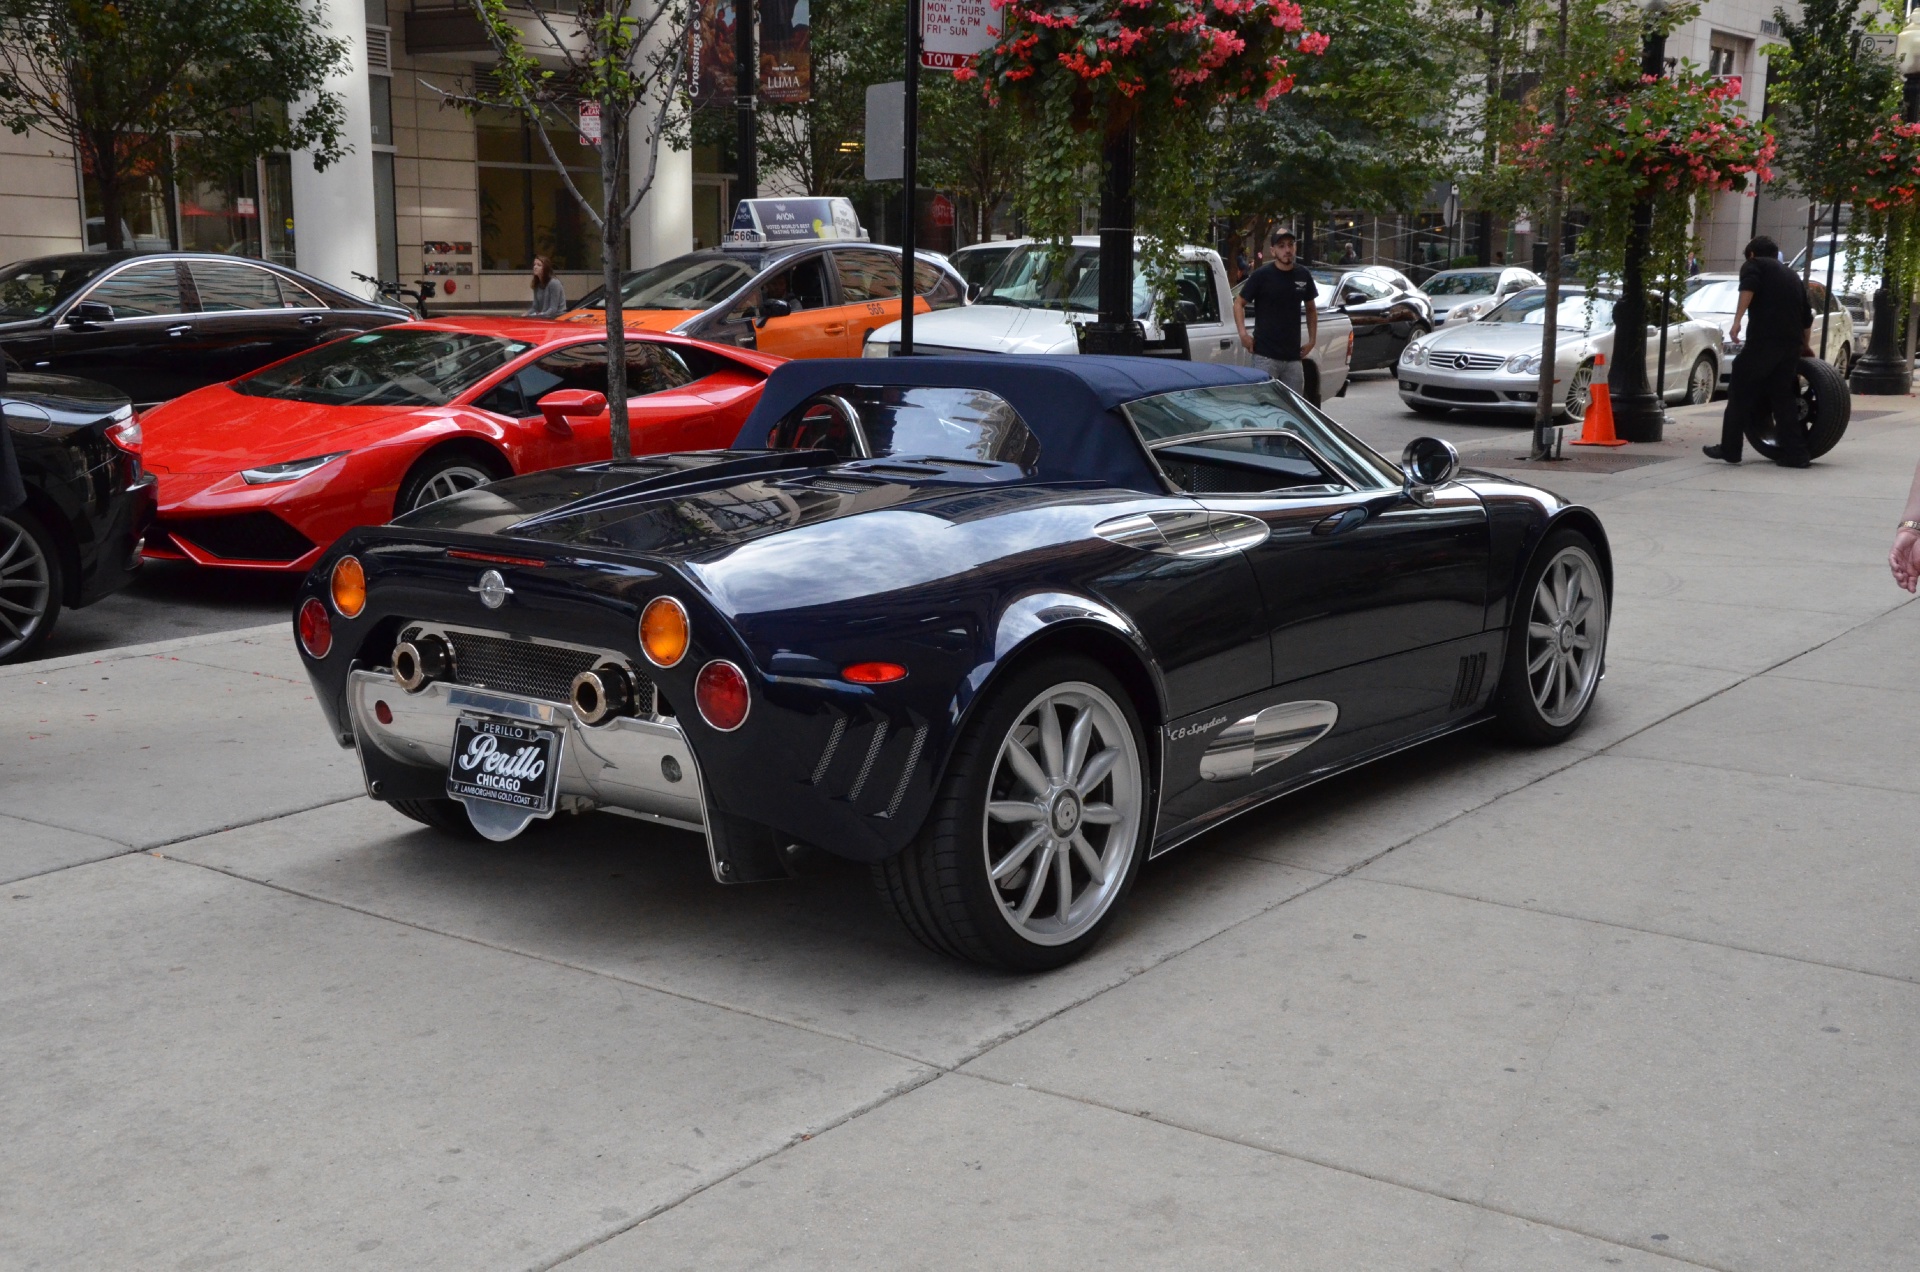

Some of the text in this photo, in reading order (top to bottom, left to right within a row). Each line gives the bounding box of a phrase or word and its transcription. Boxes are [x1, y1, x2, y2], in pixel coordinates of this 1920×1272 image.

[927, 2, 946, 12] MON
[956, 4, 986, 16] THURS
[927, 13, 935, 22] 10
[937, 15, 950, 24] AM
[960, 16, 965, 25] 6
[968, 17, 981, 26] PM
[927, 24, 941, 34] FRI
[950, 26, 968, 36] SUN
[688, 33, 703, 97] Crossings
[926, 53, 955, 66] TOW
[768, 76, 800, 88] LUMA
[734, 231, 751, 241] 566
[866, 303, 885, 316] 566
[484, 723, 523, 738] PERILLO
[1170, 715, 1227, 740] C8 Spyder
[458, 733, 545, 782] Perillo
[476, 773, 520, 792] CHICAGO
[461, 785, 531, 805] LAMBORGHINI GOLD COAST
